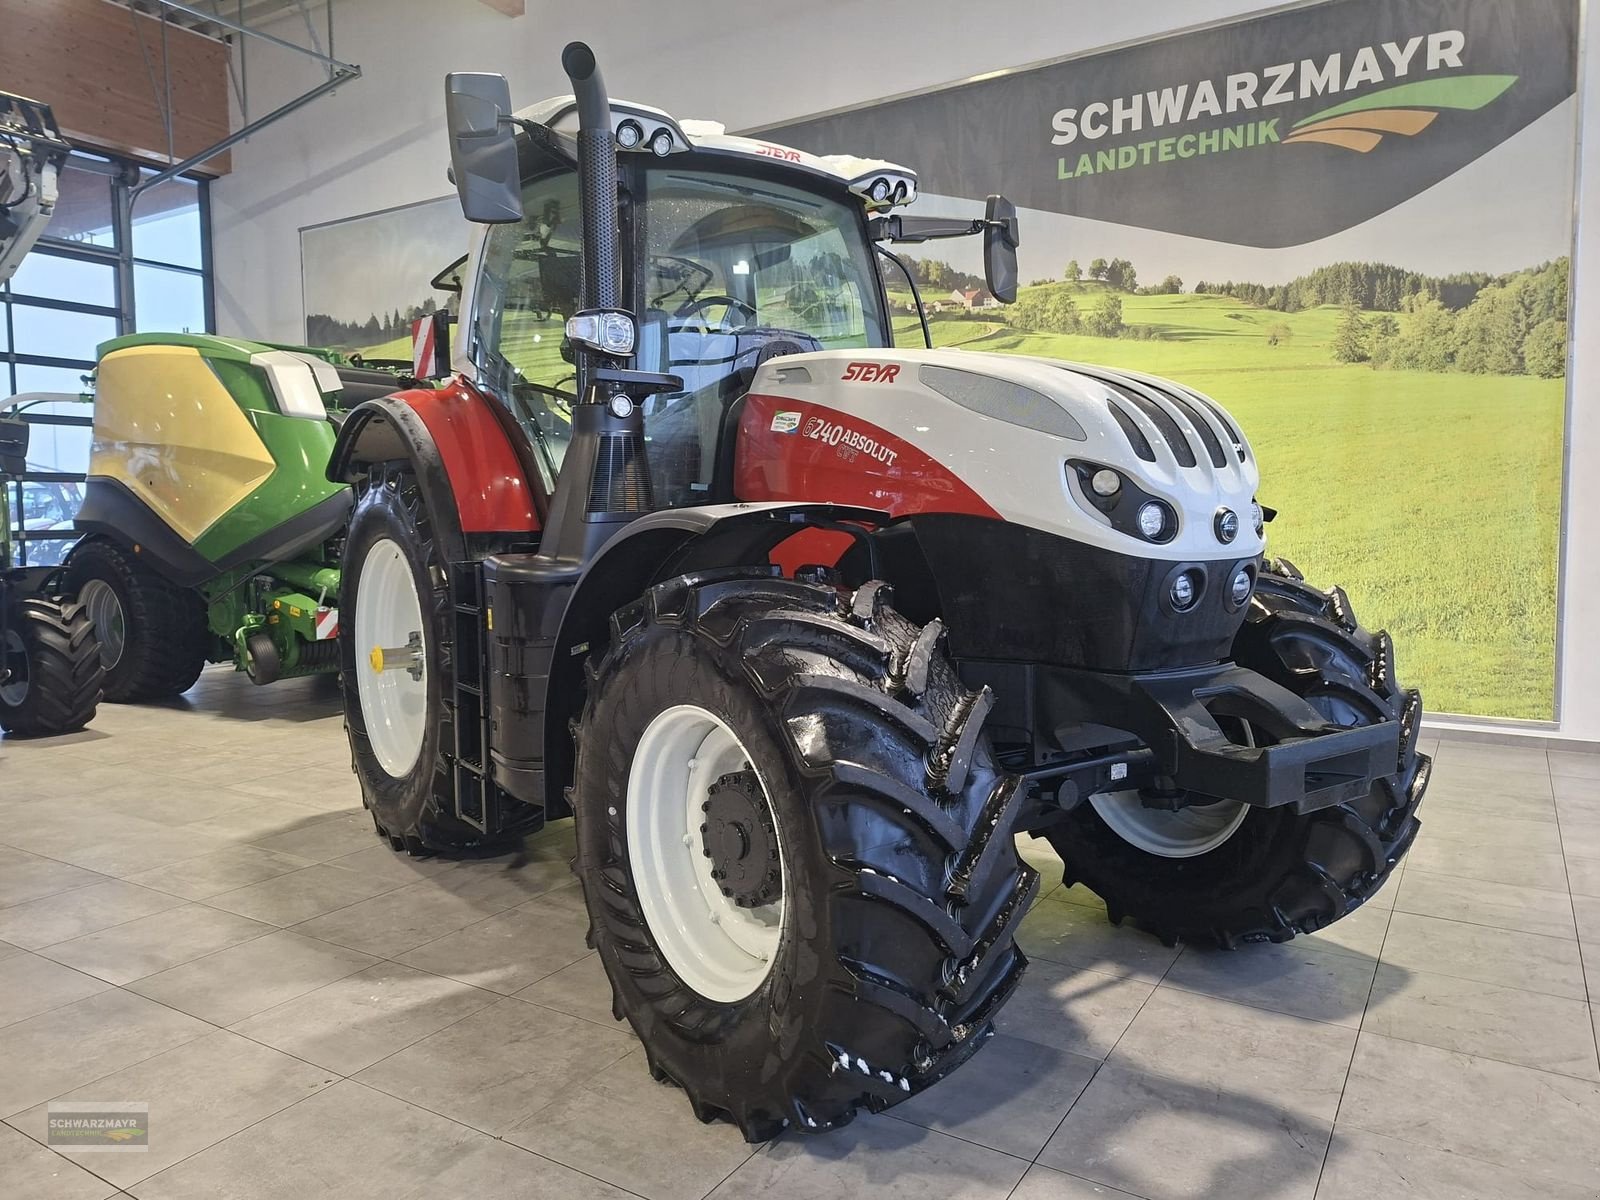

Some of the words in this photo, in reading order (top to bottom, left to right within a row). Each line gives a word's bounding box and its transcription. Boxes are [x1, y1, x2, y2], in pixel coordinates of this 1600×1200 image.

[1050, 29, 1465, 146] SCHWARZMAYR
[755, 143, 801, 163] STEYR
[1057, 117, 1281, 181] LANDTECHNIK
[841, 361, 901, 384] STEYR
[802, 416, 844, 447] 6240
[840, 429, 898, 467] ABSOLUT
